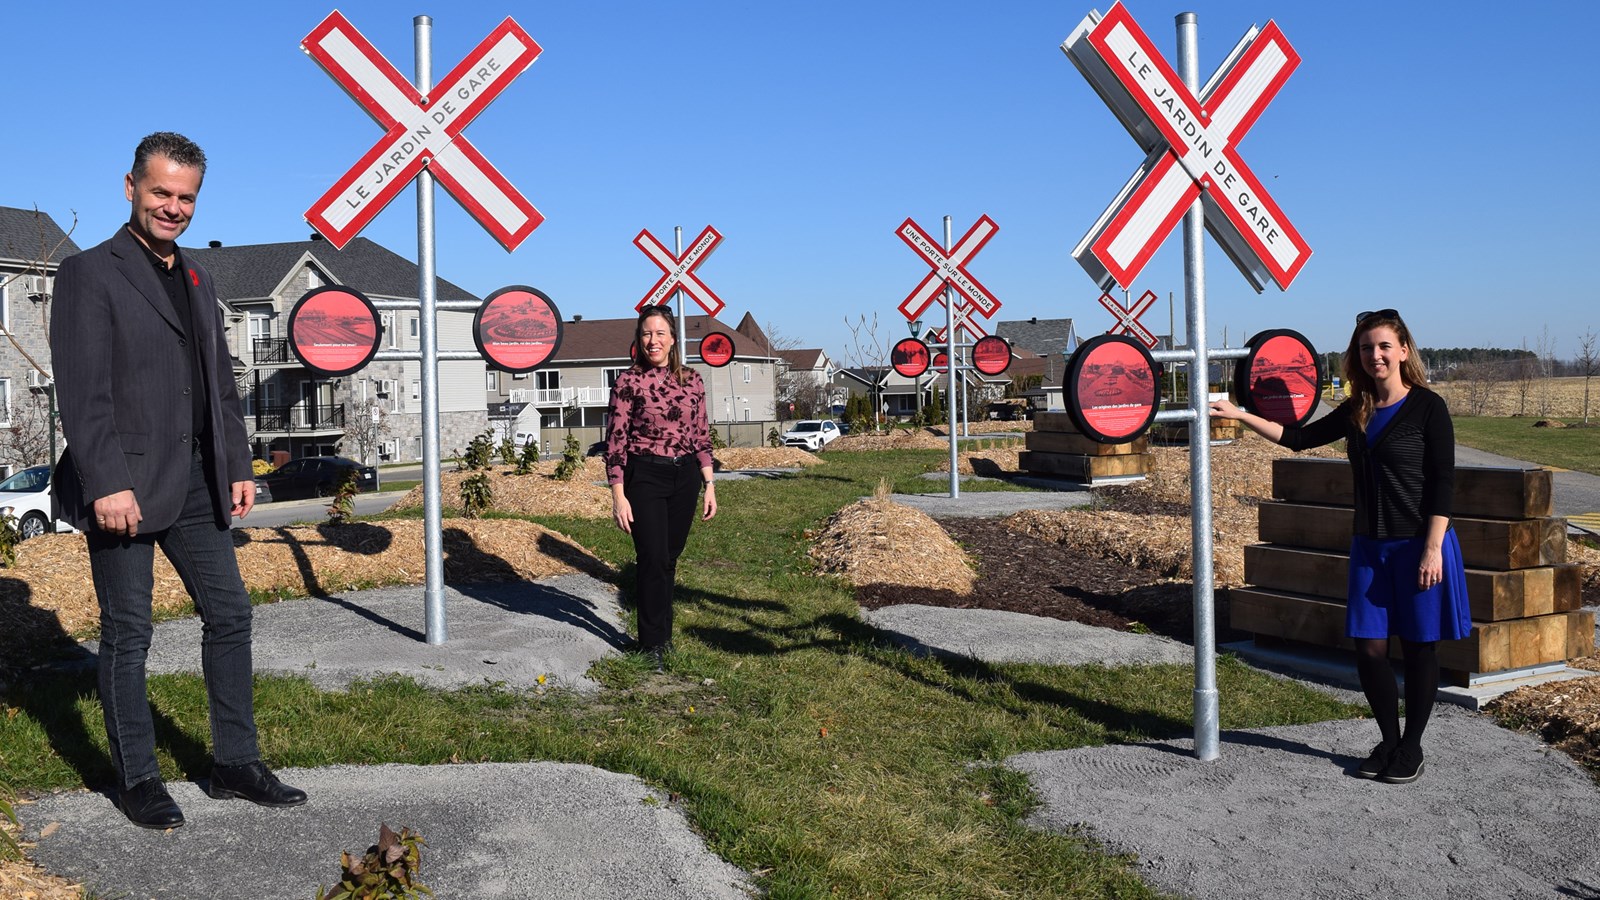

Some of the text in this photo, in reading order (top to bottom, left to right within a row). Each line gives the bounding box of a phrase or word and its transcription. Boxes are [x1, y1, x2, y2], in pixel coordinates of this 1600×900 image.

[346, 57, 502, 209] LE JARDIN DE GARE
[1128, 51, 1279, 245] LE JARDIN DE GARE
[655, 277, 675, 299] PORTE
[673, 264, 687, 278] SUR
[685, 255, 695, 265] LE
[693, 233, 714, 256] MONDE
[905, 227, 993, 310] UNE PORTE SUR LE MONDE
